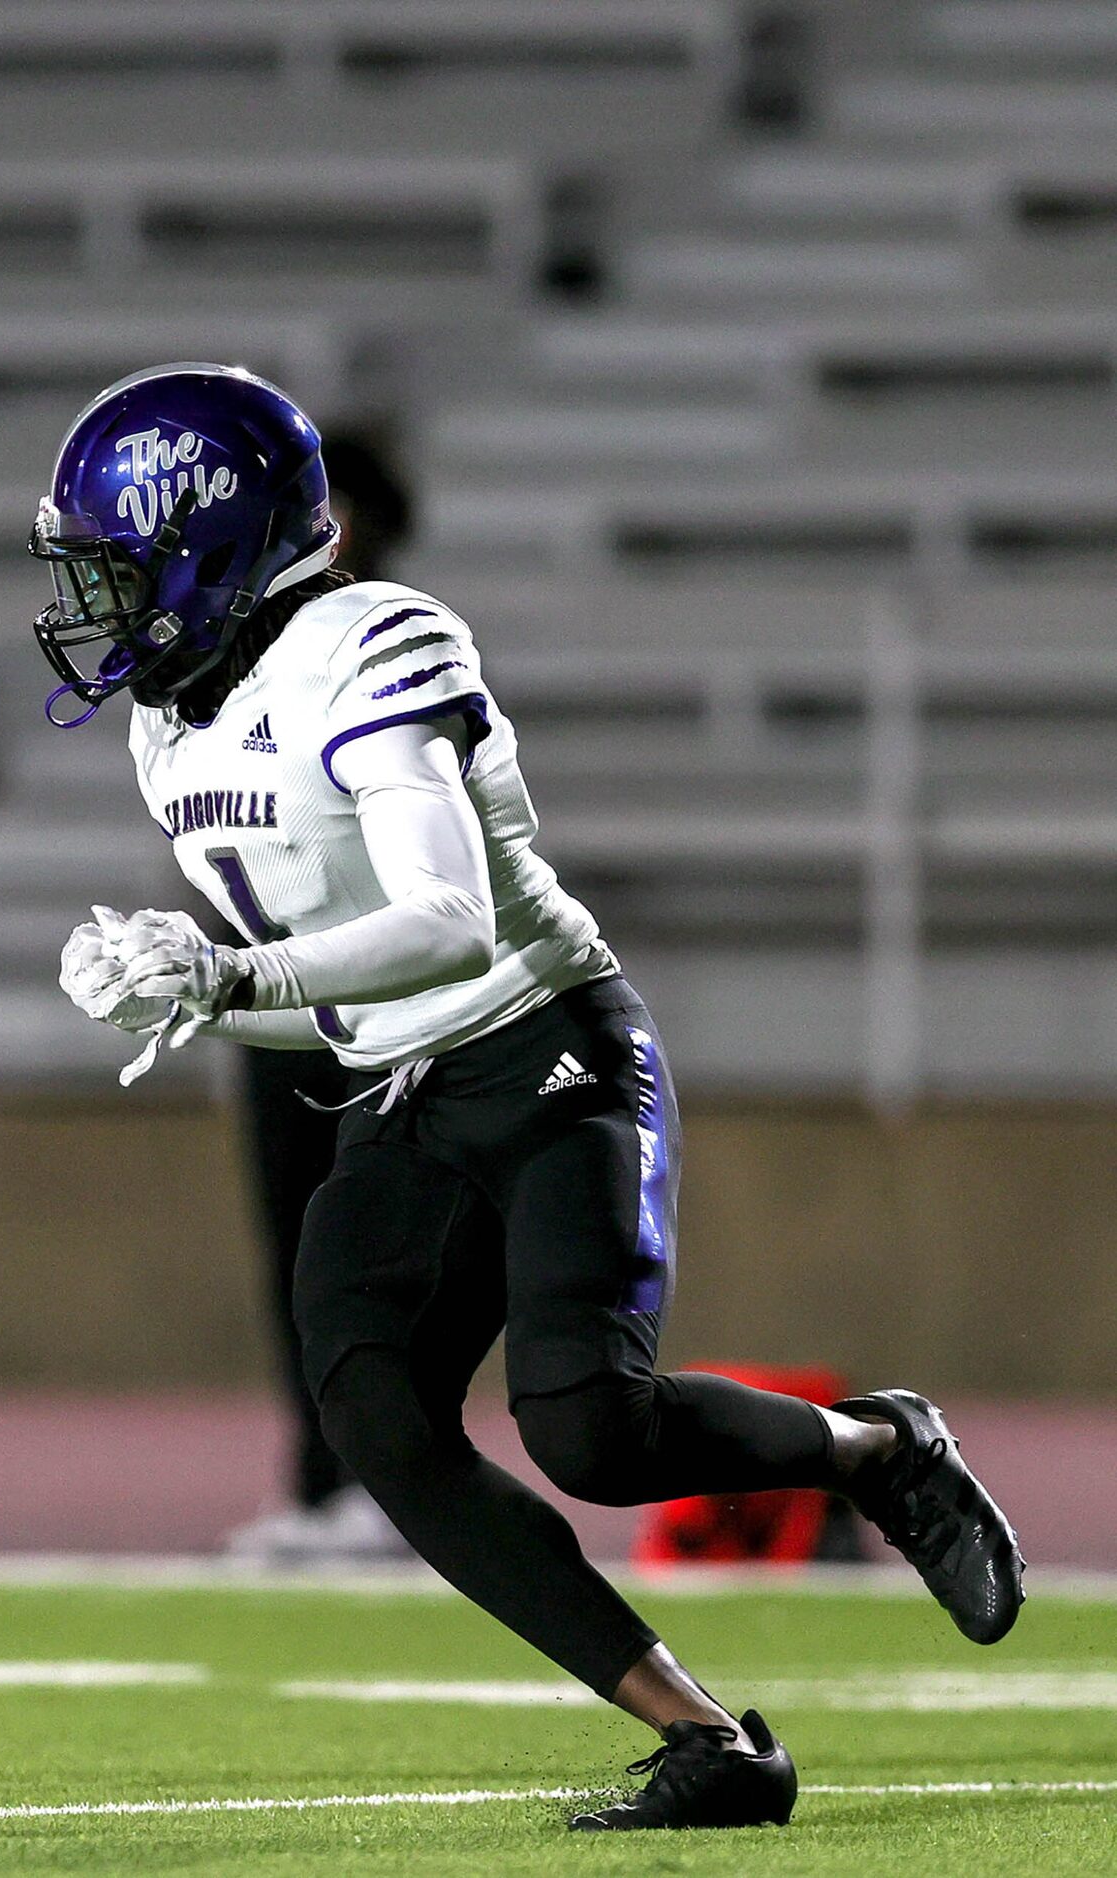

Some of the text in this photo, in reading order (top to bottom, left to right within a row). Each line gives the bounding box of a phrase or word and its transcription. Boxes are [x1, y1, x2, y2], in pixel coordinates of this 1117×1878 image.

[115, 427, 203, 485] The
[241, 736, 278, 754] adidas
[537, 1073, 598, 1095] adidas
